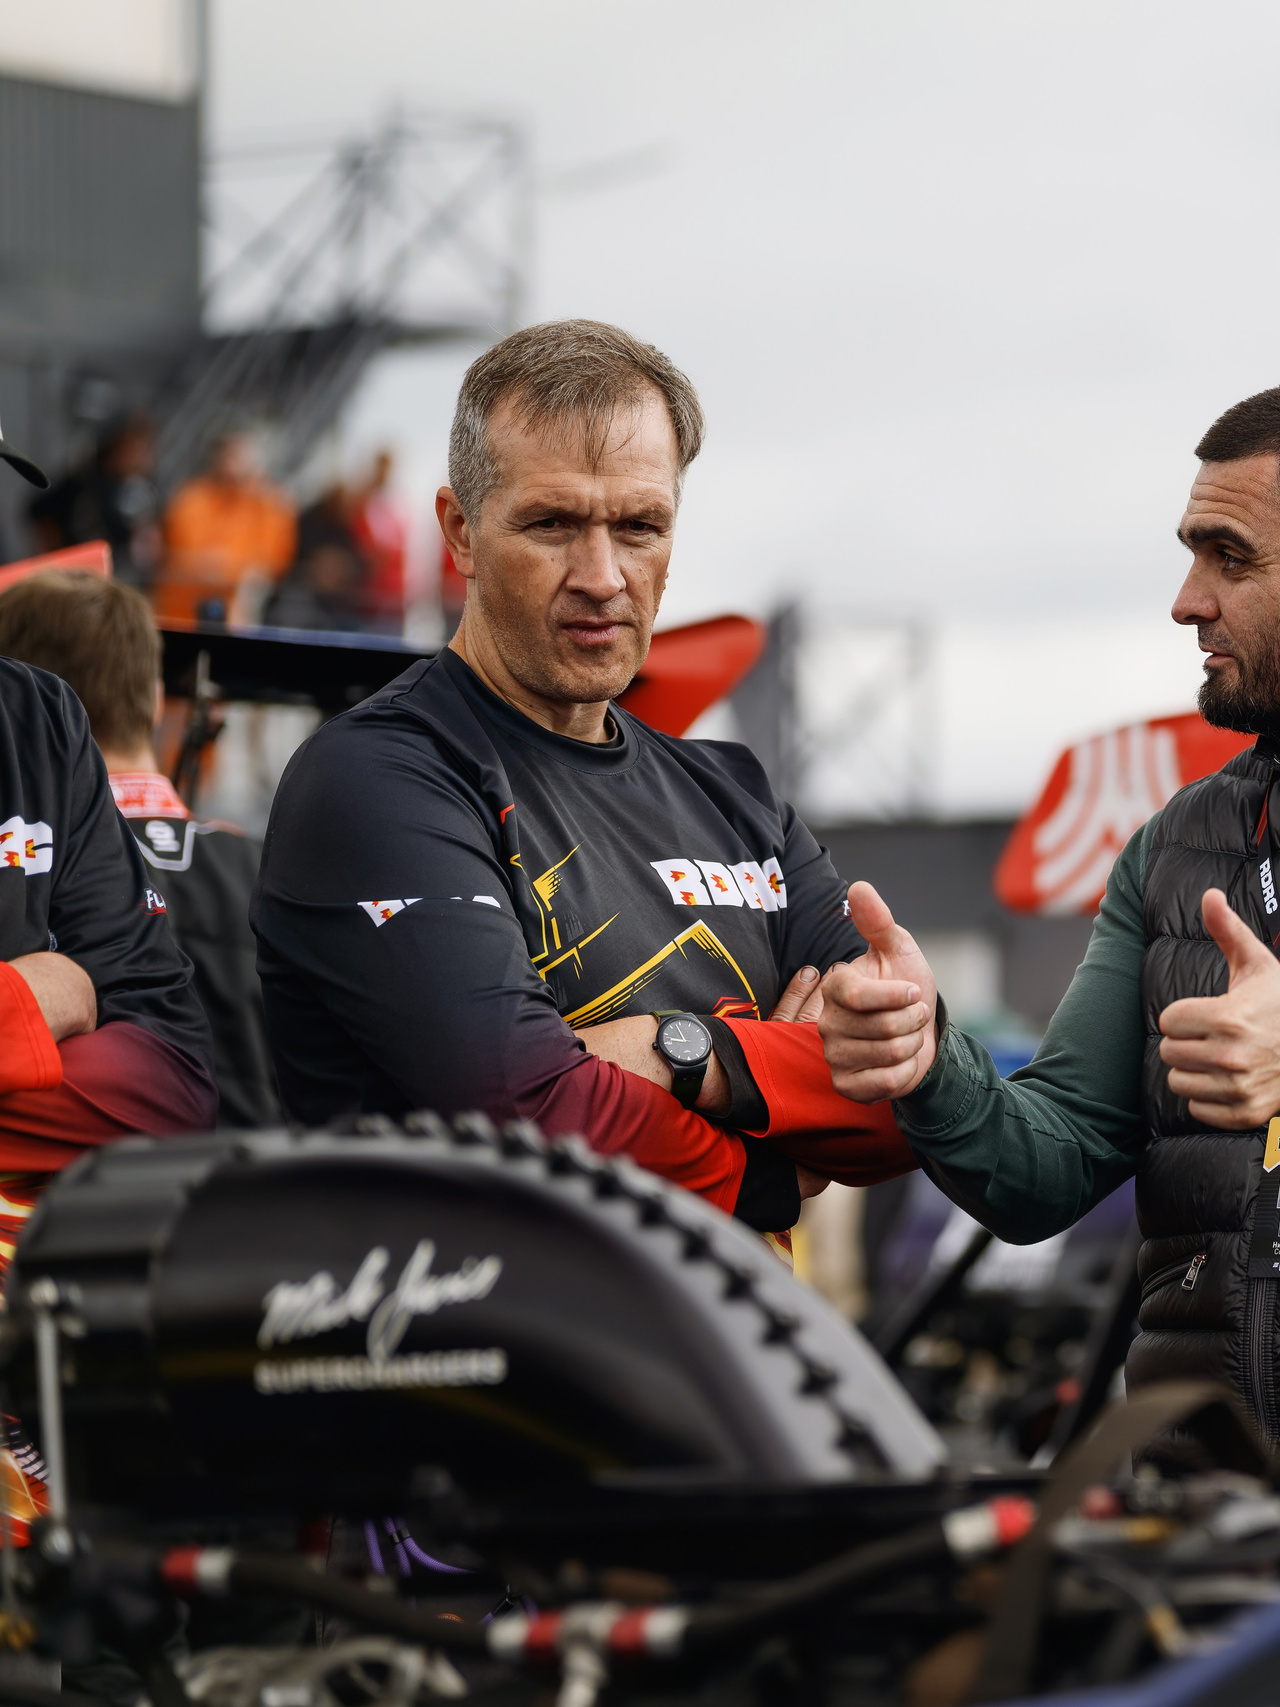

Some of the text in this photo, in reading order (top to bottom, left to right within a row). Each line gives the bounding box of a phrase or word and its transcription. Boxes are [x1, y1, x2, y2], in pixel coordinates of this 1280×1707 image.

[145, 889, 167, 910] FL
[650, 857, 787, 913] RDRC
[1260, 857, 1278, 915] RDRC
[254, 1348, 508, 1395] SUPERCHARGERS
